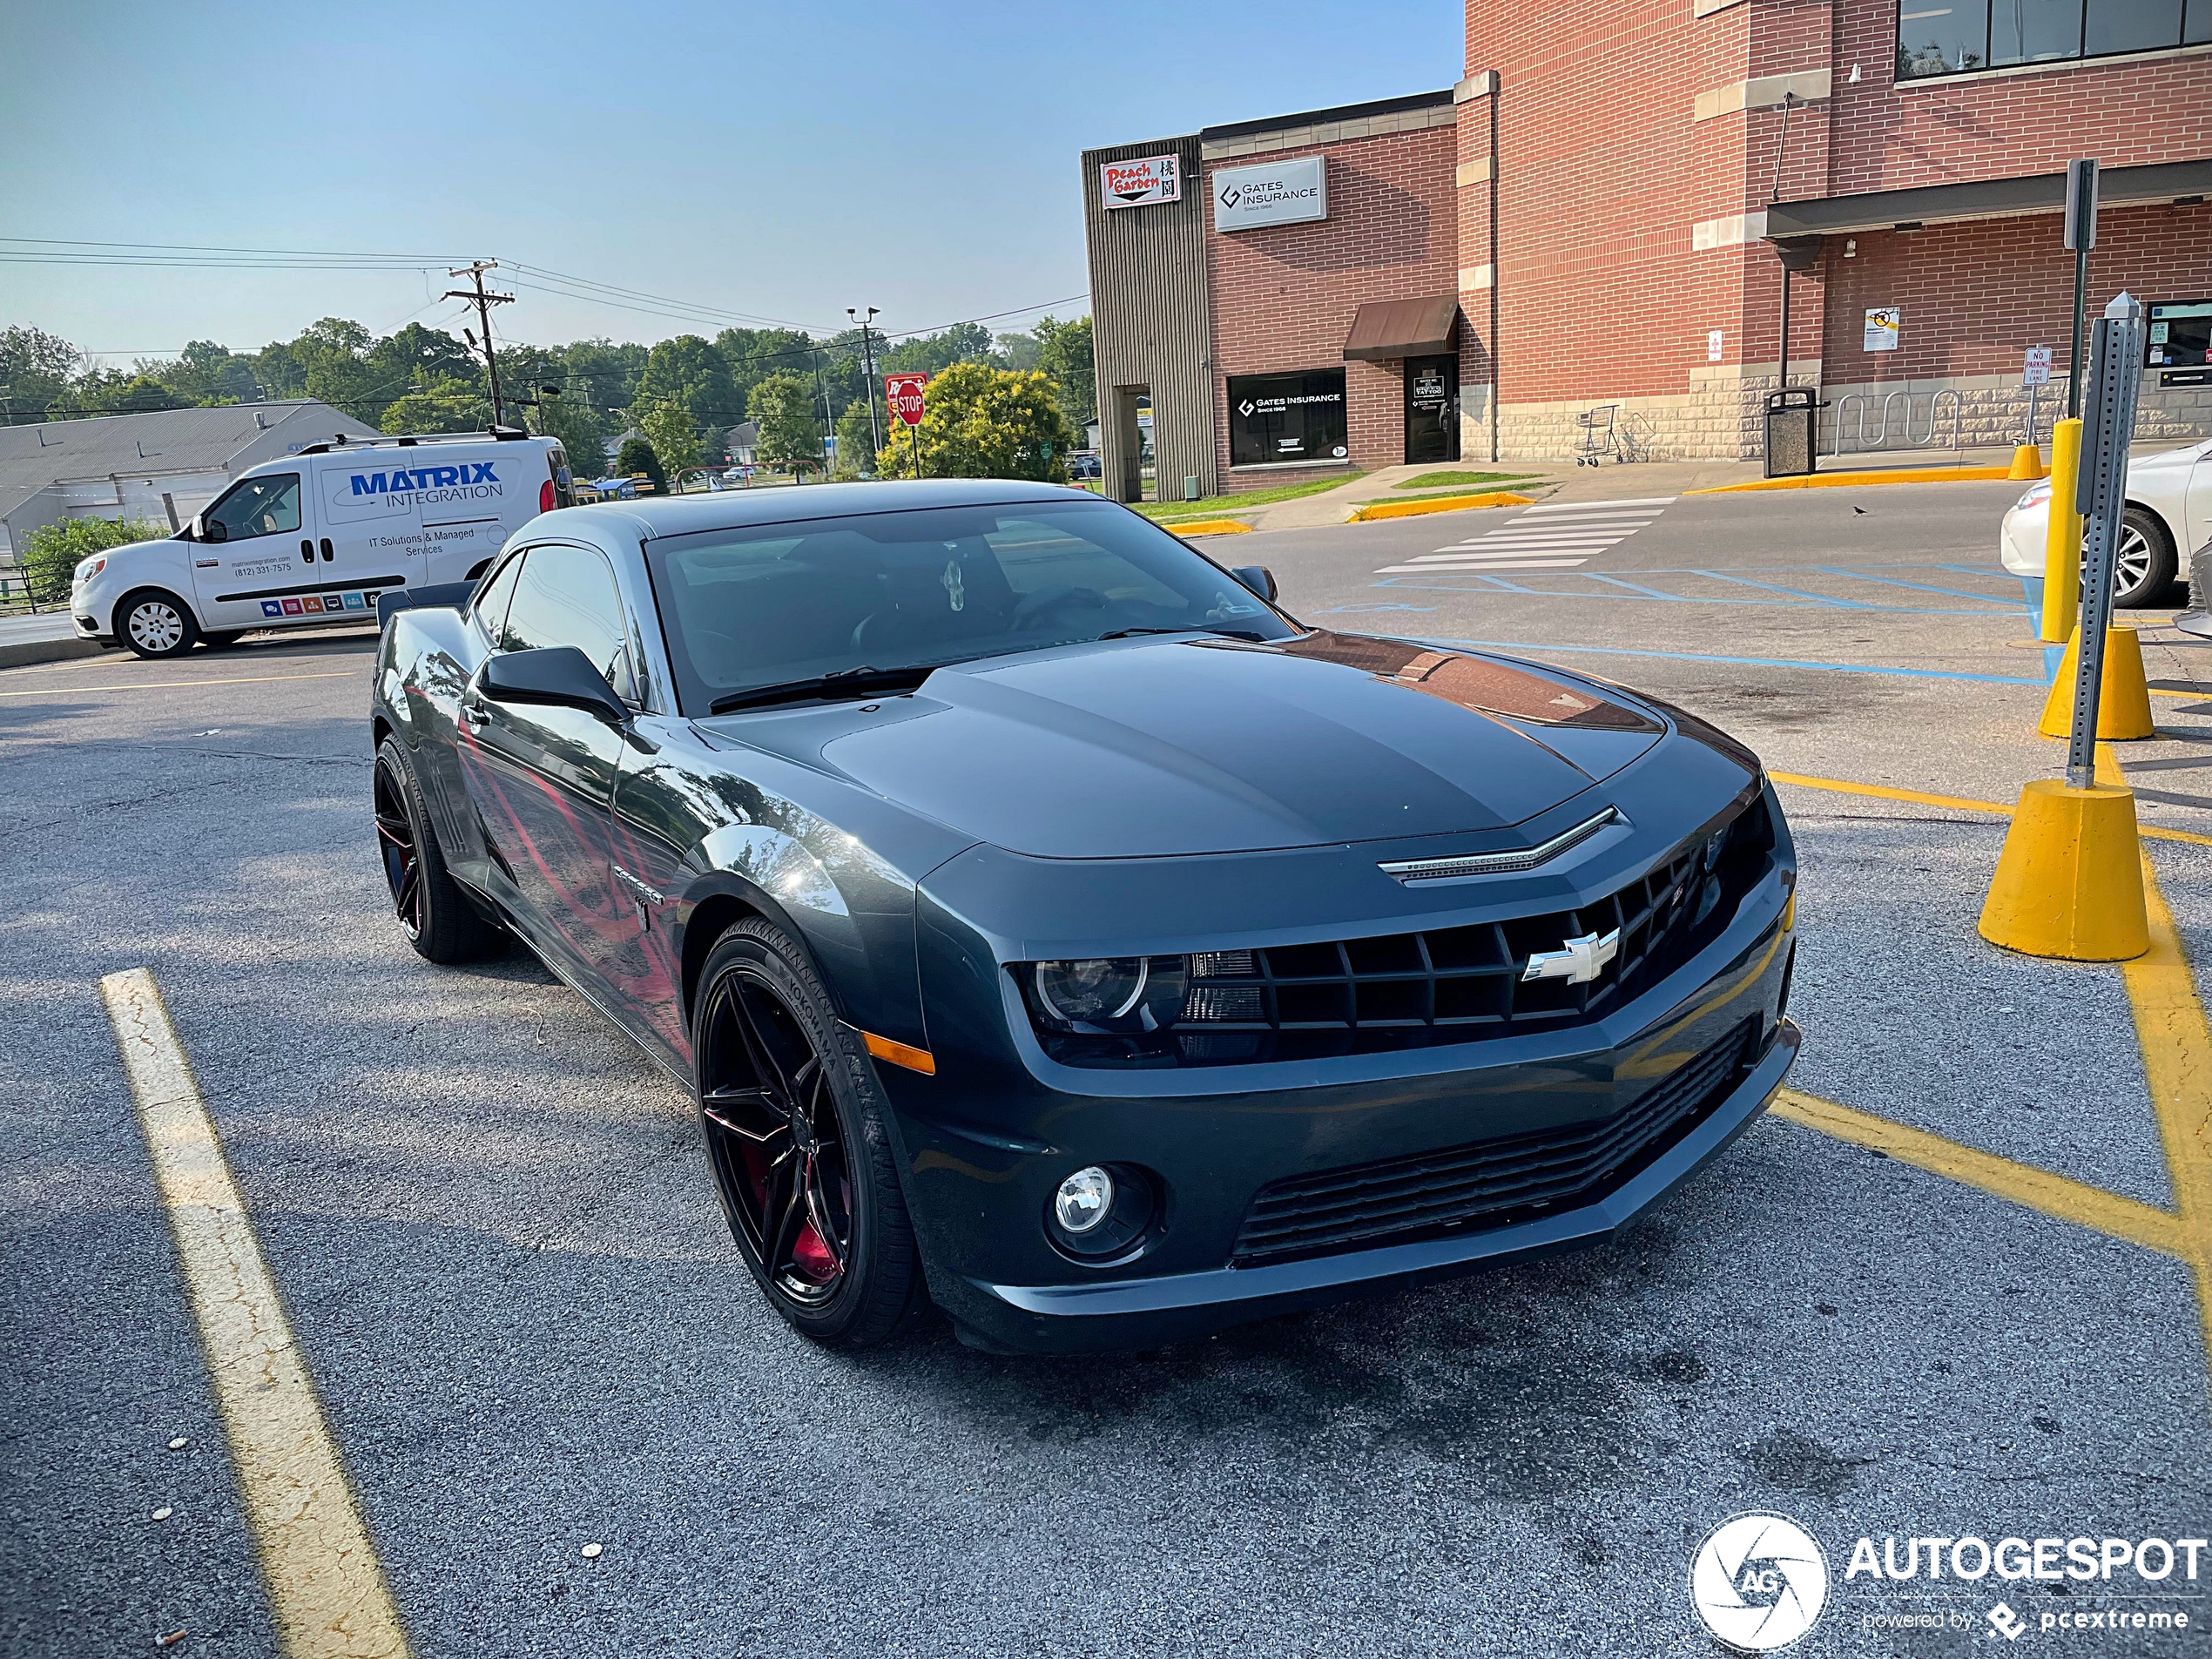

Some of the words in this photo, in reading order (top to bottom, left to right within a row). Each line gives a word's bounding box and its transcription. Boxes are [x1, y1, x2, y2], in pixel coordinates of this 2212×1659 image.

[1106, 163, 1151, 189] Peach
[1114, 178, 1160, 193] Garden
[1242, 181, 1284, 194] GATES
[1243, 188, 1318, 205] INSURANCE
[898, 395, 922, 413] STOP
[1256, 398, 1285, 407] GATES
[1287, 394, 1340, 404] INSURANCE
[350, 462, 501, 496] MATRIX
[386, 484, 503, 508] INTEGRATION
[369, 537, 378, 547] IT
[381, 535, 422, 547] Solutions
[425, 532, 432, 542] &
[435, 529, 475, 541] Managed
[406, 545, 443, 556] Services
[231, 556, 291, 568] matrixintegration.com
[235, 568, 255, 578] (812)
[256, 563, 292, 575] 331-7575
[789, 977, 836, 1071] YOKOHAMA
